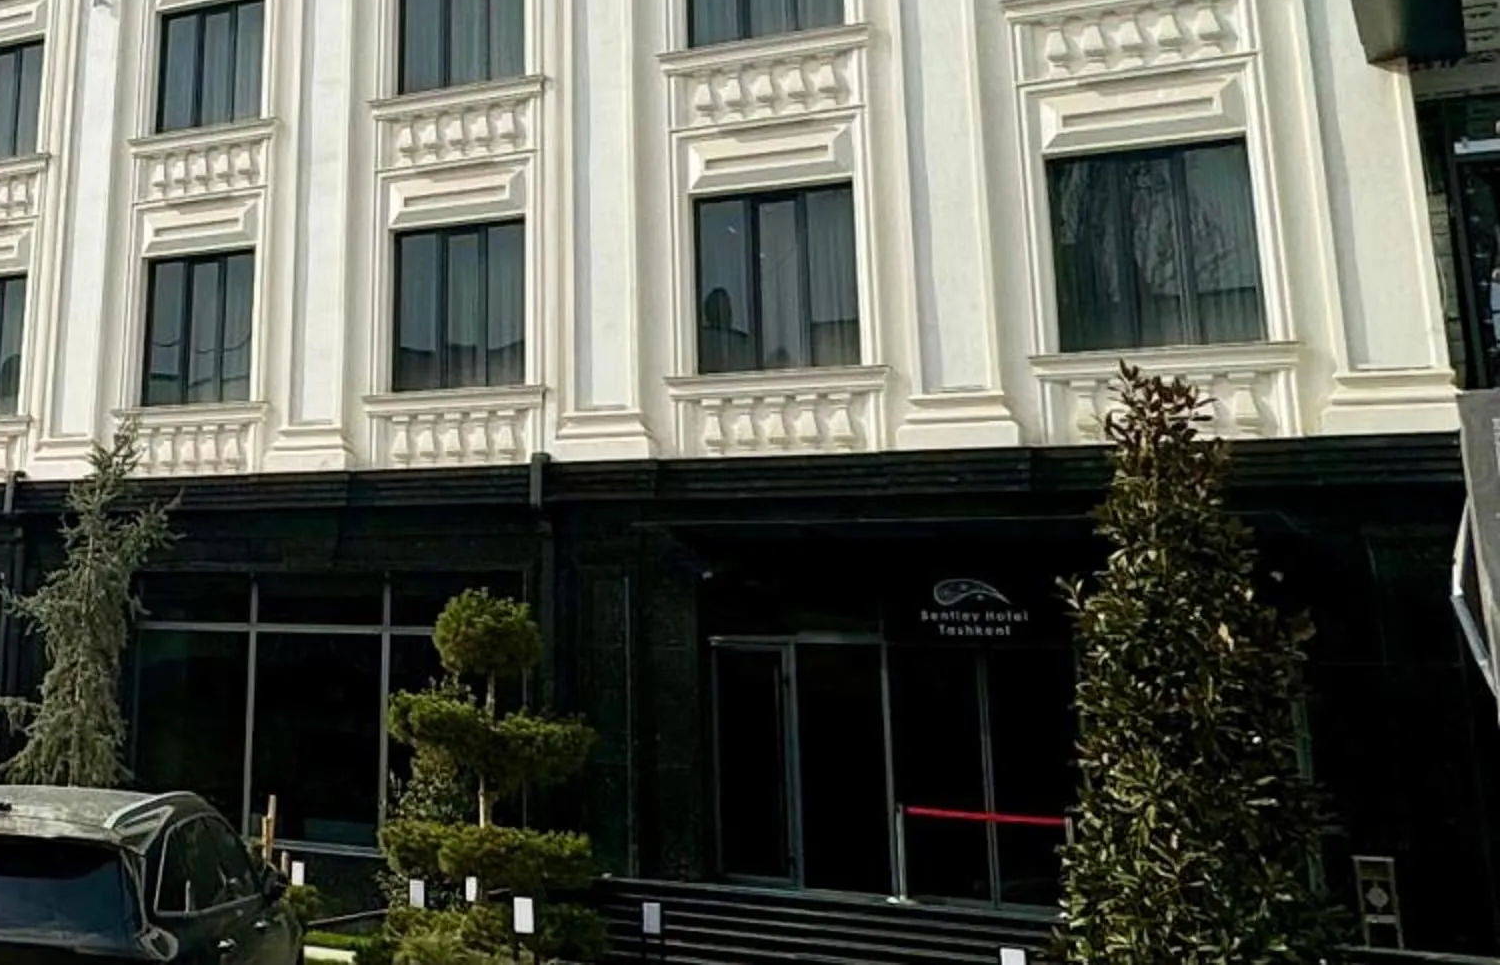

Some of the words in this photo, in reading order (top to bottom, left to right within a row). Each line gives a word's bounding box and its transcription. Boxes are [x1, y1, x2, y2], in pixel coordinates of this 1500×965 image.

[921, 610, 981, 623] Bentley
[985, 610, 1028, 622] Hotel
[939, 624, 1011, 636] Tashkent
